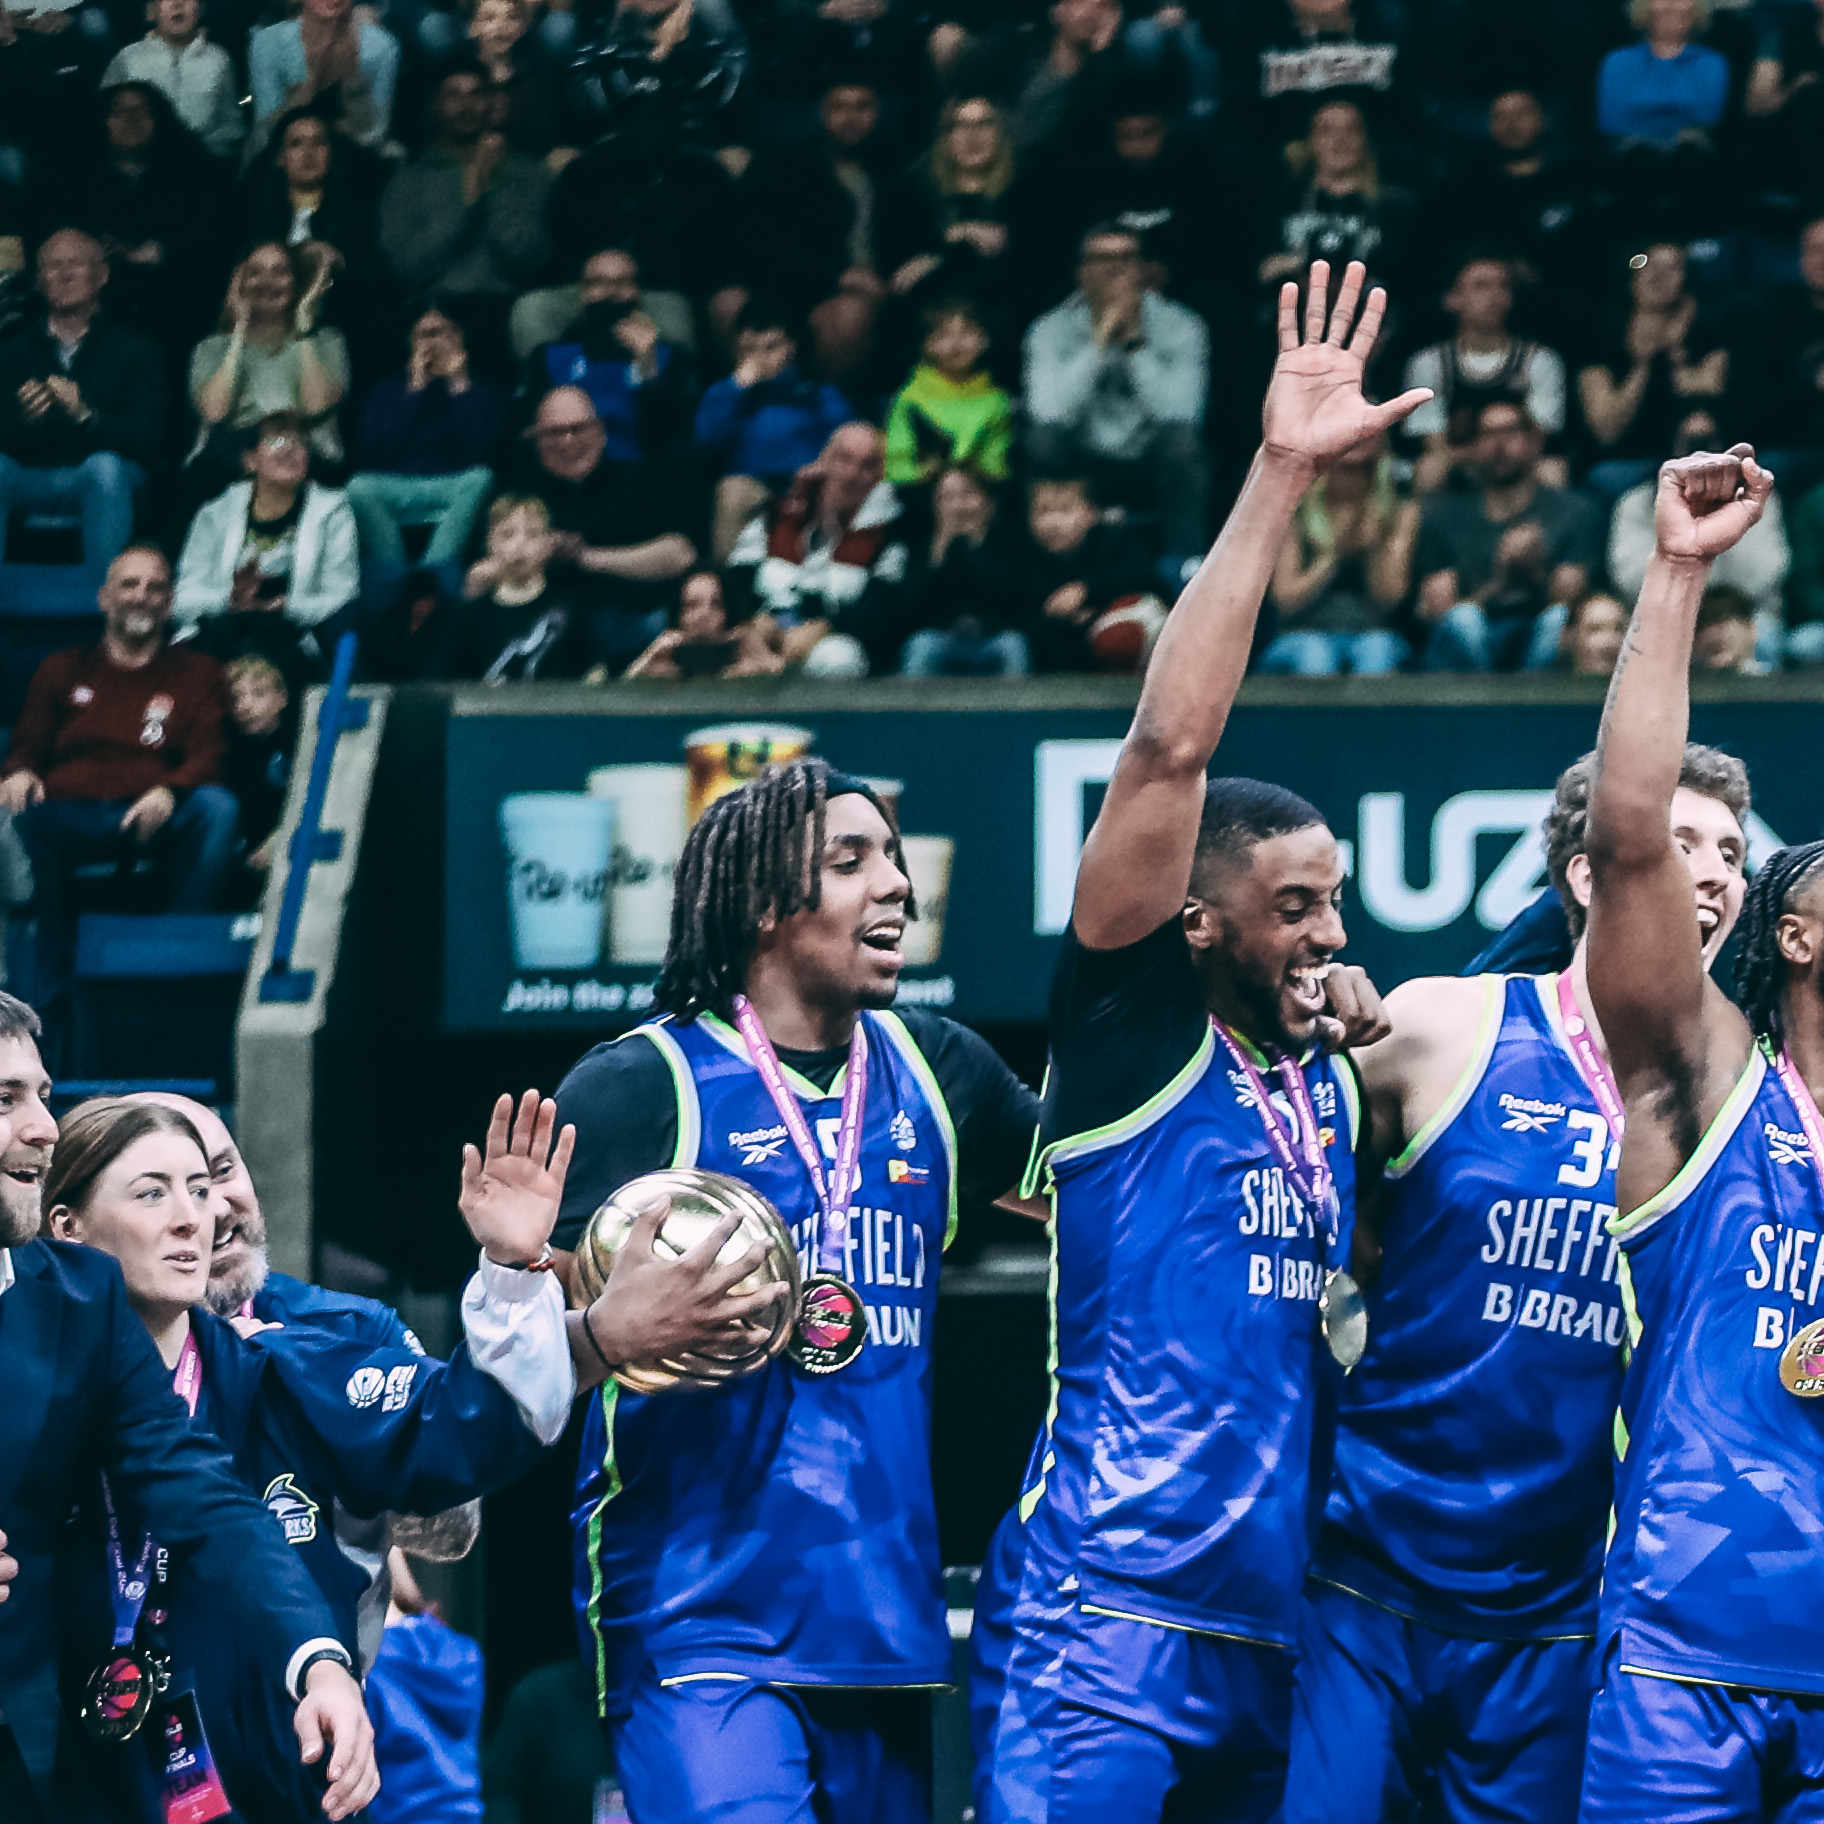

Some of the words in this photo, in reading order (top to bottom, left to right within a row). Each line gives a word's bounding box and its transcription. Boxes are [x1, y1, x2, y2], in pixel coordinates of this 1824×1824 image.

[1499, 1093, 1567, 1117] Reebok
[1764, 1122, 1809, 1146] Reeb
[1518, 1289, 1628, 1347] BRAU
[156, 1547, 169, 1584] CUP
